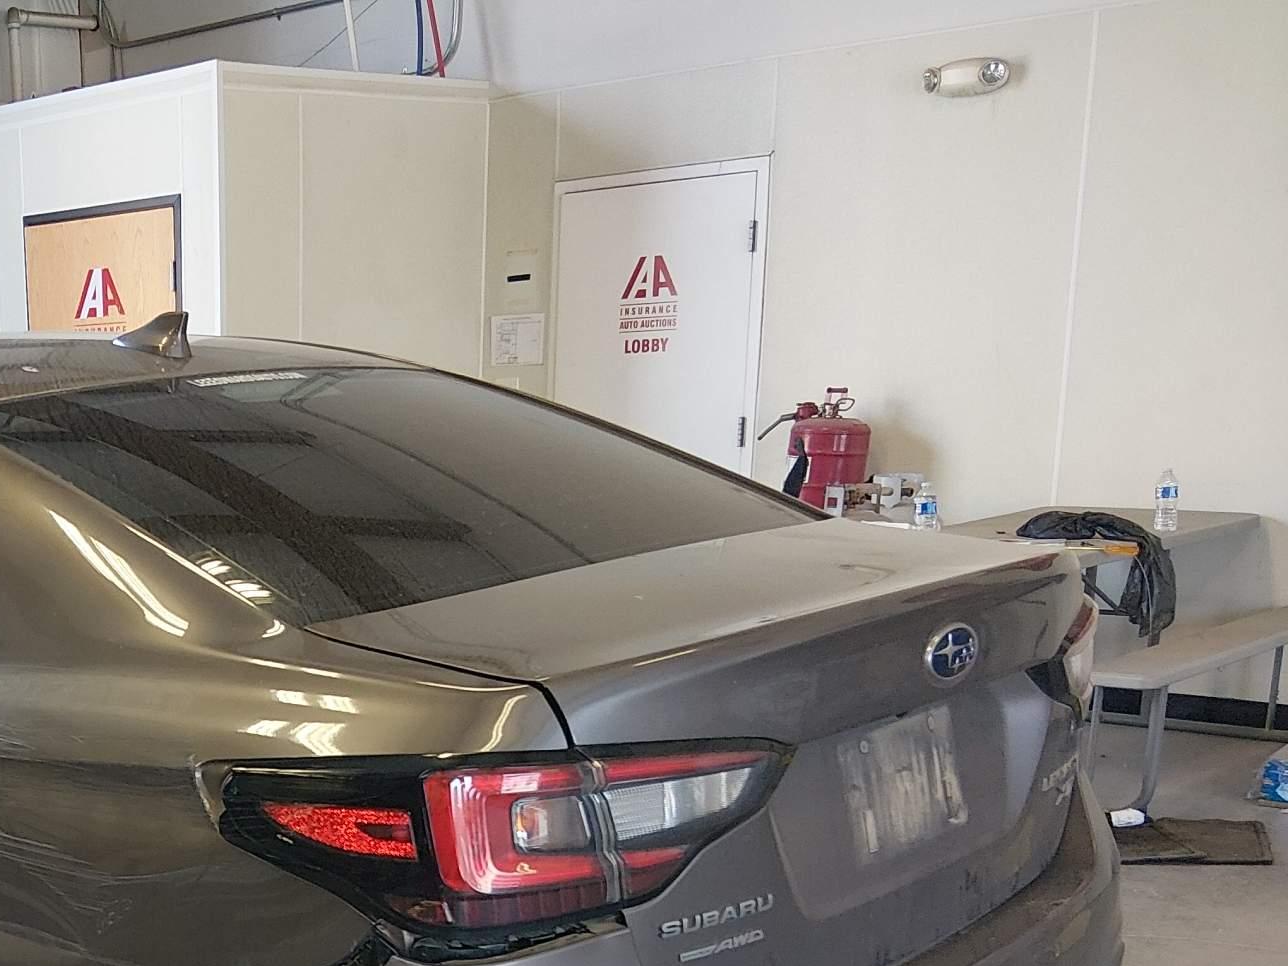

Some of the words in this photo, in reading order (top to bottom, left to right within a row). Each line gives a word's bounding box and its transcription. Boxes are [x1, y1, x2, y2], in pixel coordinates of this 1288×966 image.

[620, 304, 678, 317] INSURANCE
[619, 320, 639, 330] AUTO
[640, 318, 677, 329] AUCTIONS
[624, 338, 669, 354] LOBBY
[658, 893, 774, 939] SUBARU
[714, 929, 764, 954] AWD
